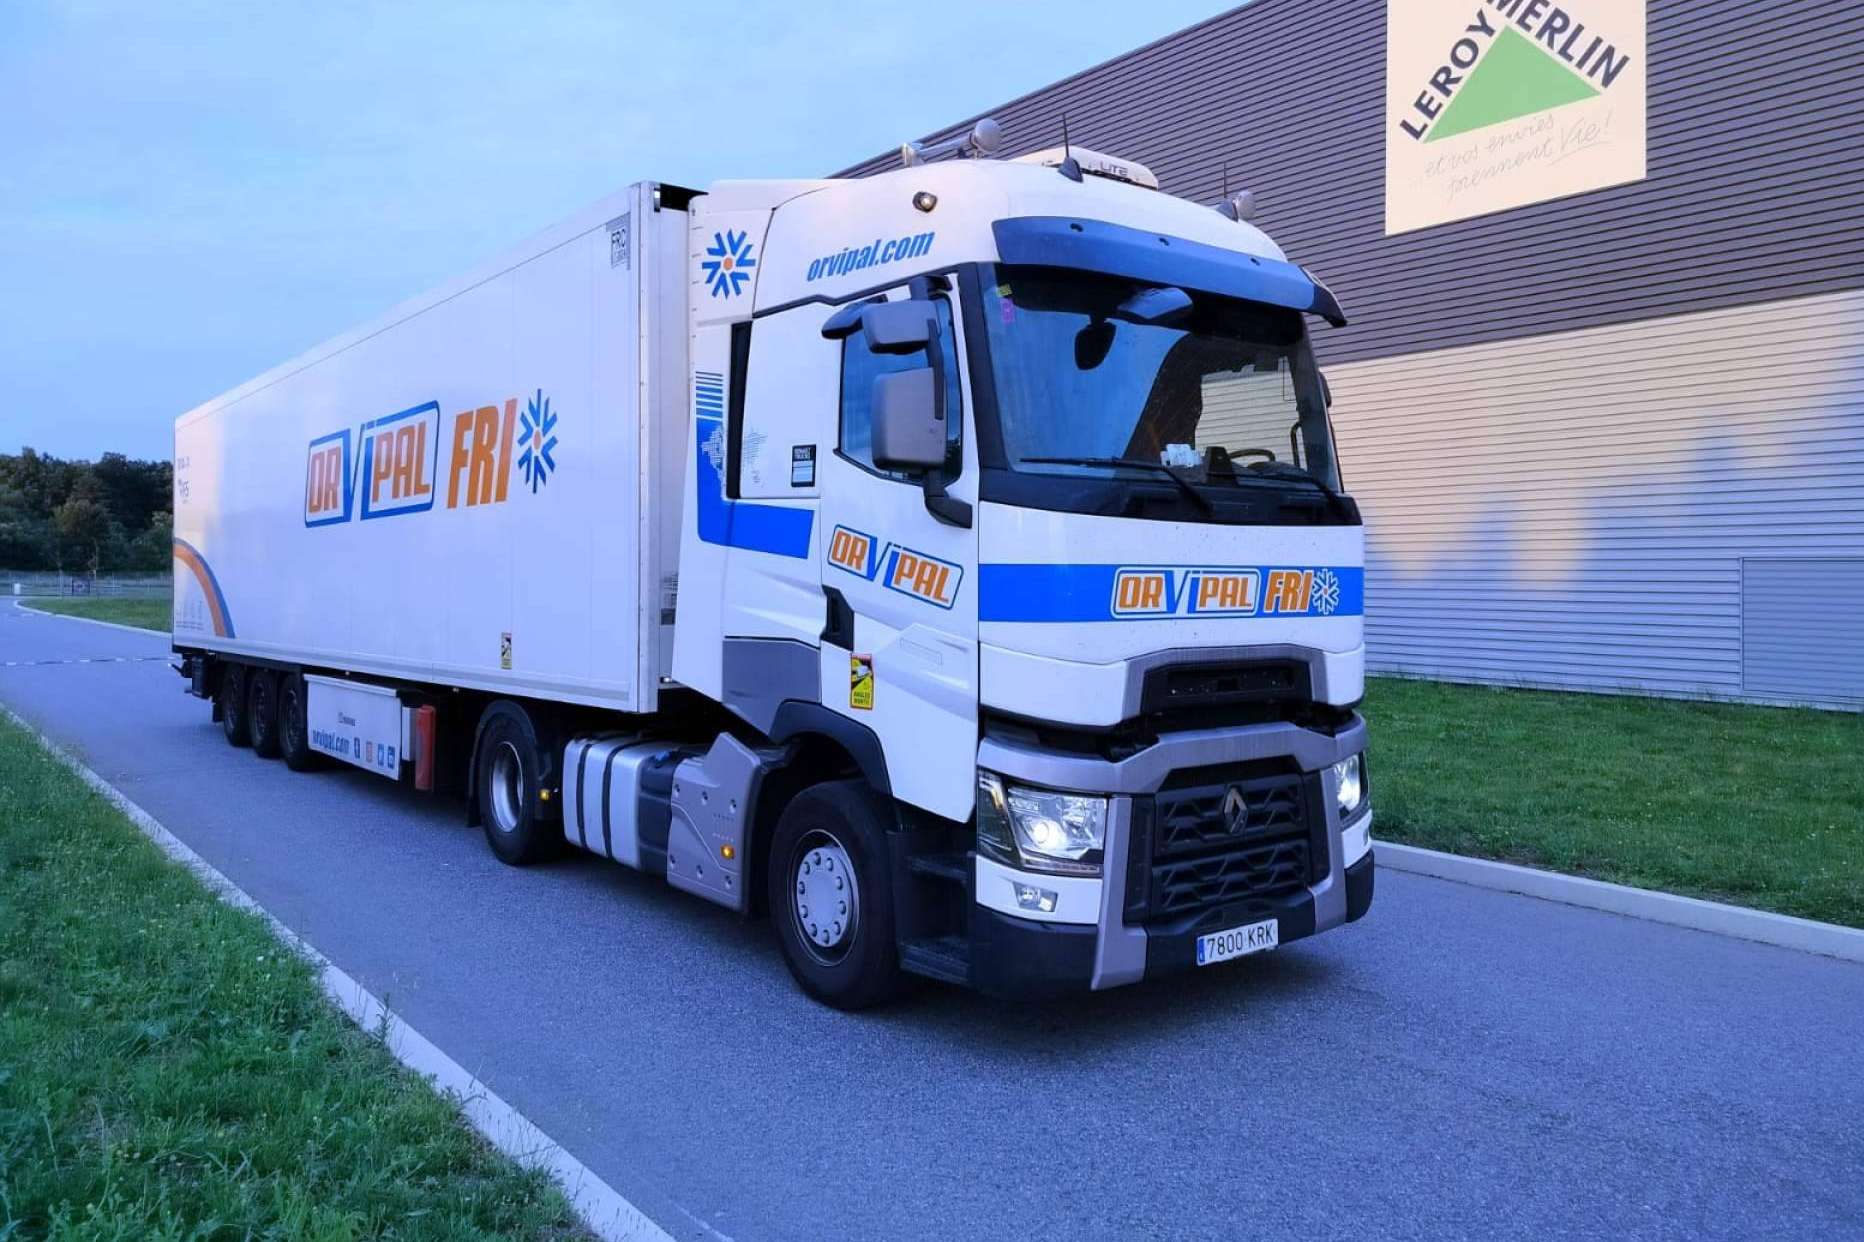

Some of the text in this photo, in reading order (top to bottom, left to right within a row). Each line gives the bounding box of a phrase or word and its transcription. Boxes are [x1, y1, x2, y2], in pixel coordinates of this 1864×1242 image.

[1399, 10, 1496, 140] LEROY
[807, 232, 935, 282] orvipal.com
[1206, 923, 1274, 958] 7800 KRK
